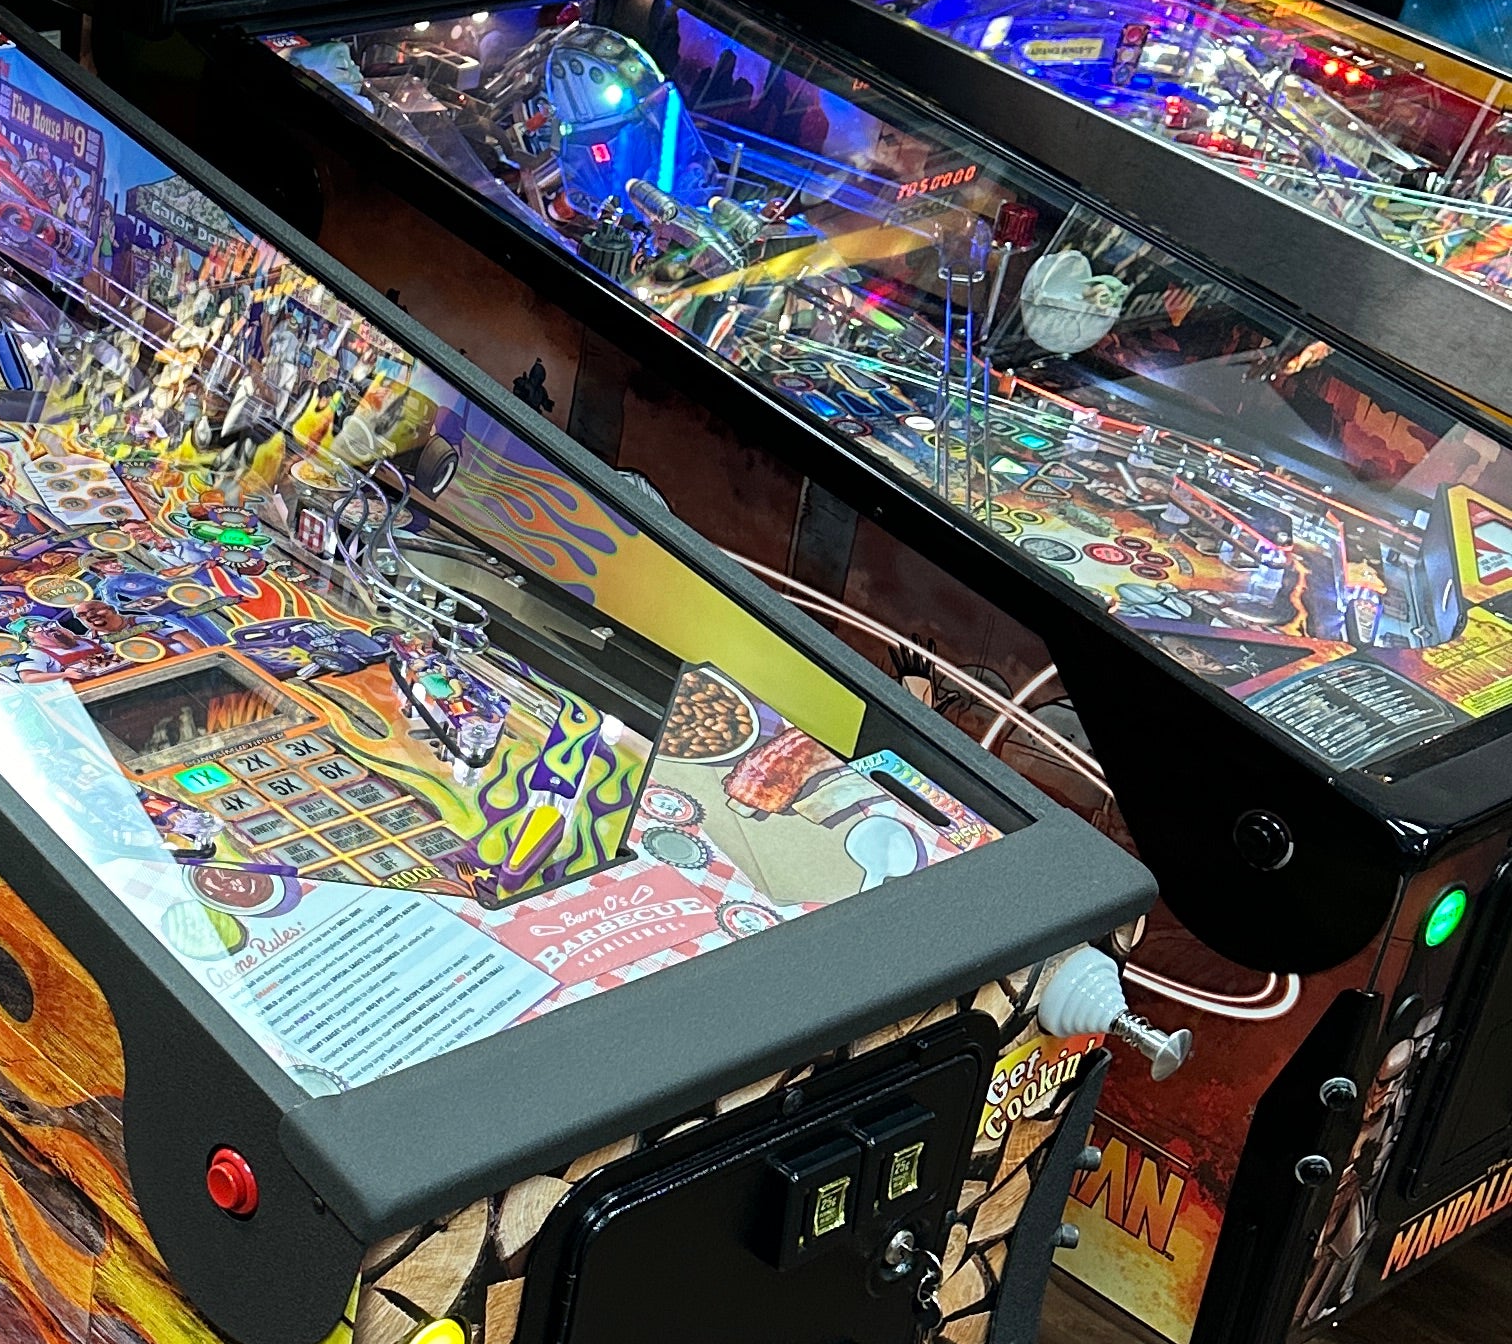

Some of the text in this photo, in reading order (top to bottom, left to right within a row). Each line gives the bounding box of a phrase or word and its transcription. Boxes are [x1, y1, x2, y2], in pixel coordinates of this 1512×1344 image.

[11, 91, 61, 143] Fire House
[288, 738, 320, 757] 3X
[238, 755, 271, 773] 2X
[317, 761, 354, 781] 6X
[188, 770, 220, 788] 1X
[270, 776, 304, 797] 5X
[222, 793, 253, 812] 4X
[291, 848, 319, 865] NIGHT
[420, 838, 461, 857] DELIVERY
[560, 893, 630, 927] Barry O's
[532, 895, 711, 975] BARBECUE
[582, 921, 679, 965] CHALLENGE
[204, 910, 306, 991] Game Rules:
[986, 1049, 1042, 1105] Get
[985, 1036, 1096, 1140] Cookin'
